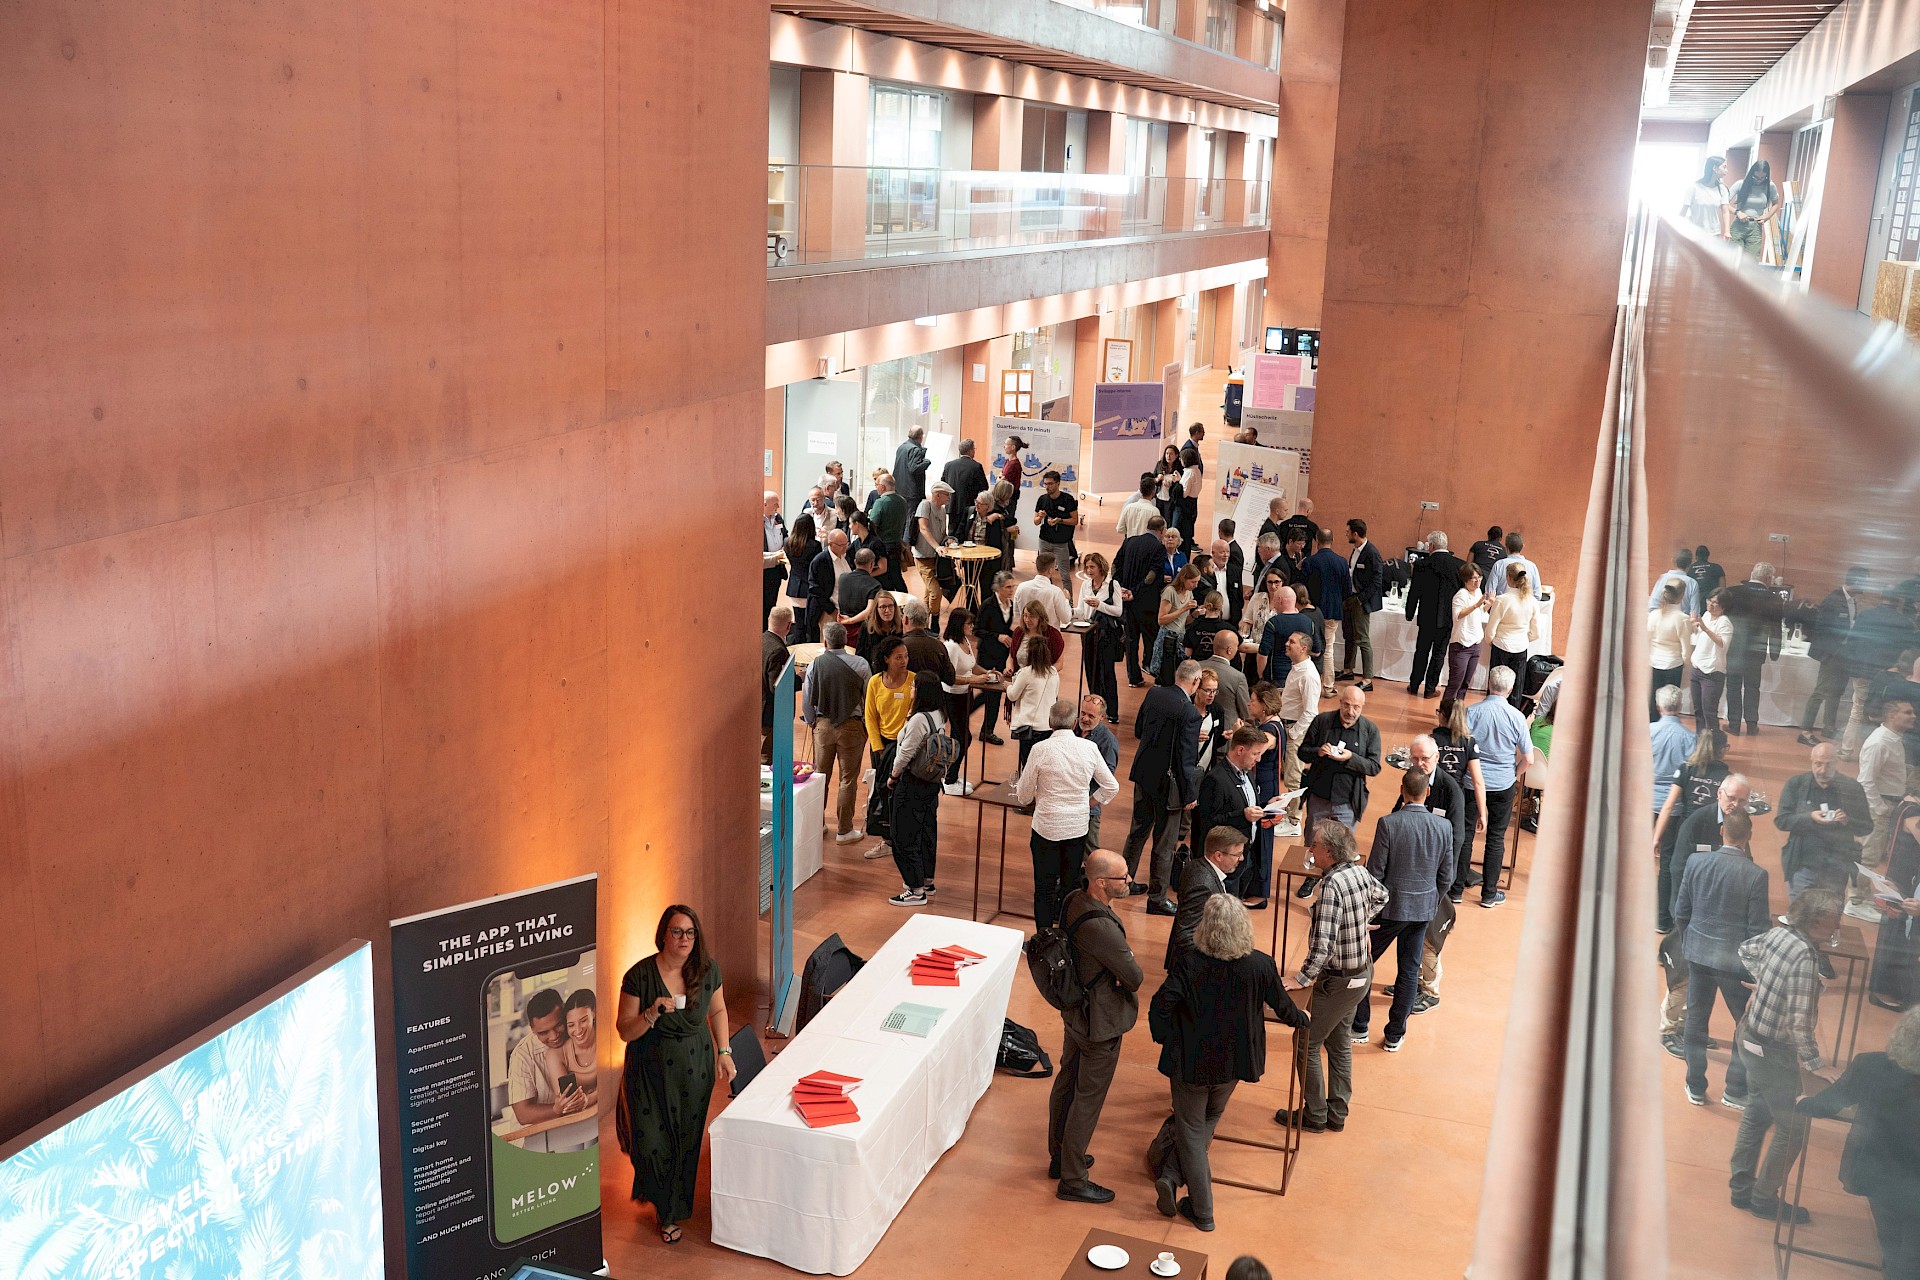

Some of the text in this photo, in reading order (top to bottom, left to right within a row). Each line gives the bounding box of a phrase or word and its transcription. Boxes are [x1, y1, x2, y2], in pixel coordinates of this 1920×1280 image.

[439, 913, 557, 952] THE APP THAT
[422, 925, 573, 972] SIMPLIFIES LIVING
[407, 1016, 451, 1034] FEATURES
[408, 1033, 466, 1054] Apartment search
[408, 1054, 463, 1074] Apartment tours
[410, 1071, 476, 1094] Lease management:
[410, 1078, 470, 1100] creation, electronic
[410, 1082, 479, 1108] signing, and archiving
[411, 1112, 450, 1128] Secure rent
[411, 1121, 441, 1135] payment
[413, 1142, 435, 1154] Digital
[413, 1157, 454, 1173] Smart home
[414, 1156, 472, 1180] management and
[120, 1125, 288, 1249] DEVELOPING
[414, 1168, 457, 1186] consumption
[415, 1177, 450, 1193] monitoring
[415, 1188, 472, 1212] Online assistance:
[512, 1176, 577, 1209] MELOW
[416, 1194, 475, 1218] report and manage
[512, 1197, 557, 1217] BETTER LIVING
[416, 1215, 436, 1225] issues
[440, 1224, 460, 1236] MUCH
[462, 1215, 484, 1228] MORE!
